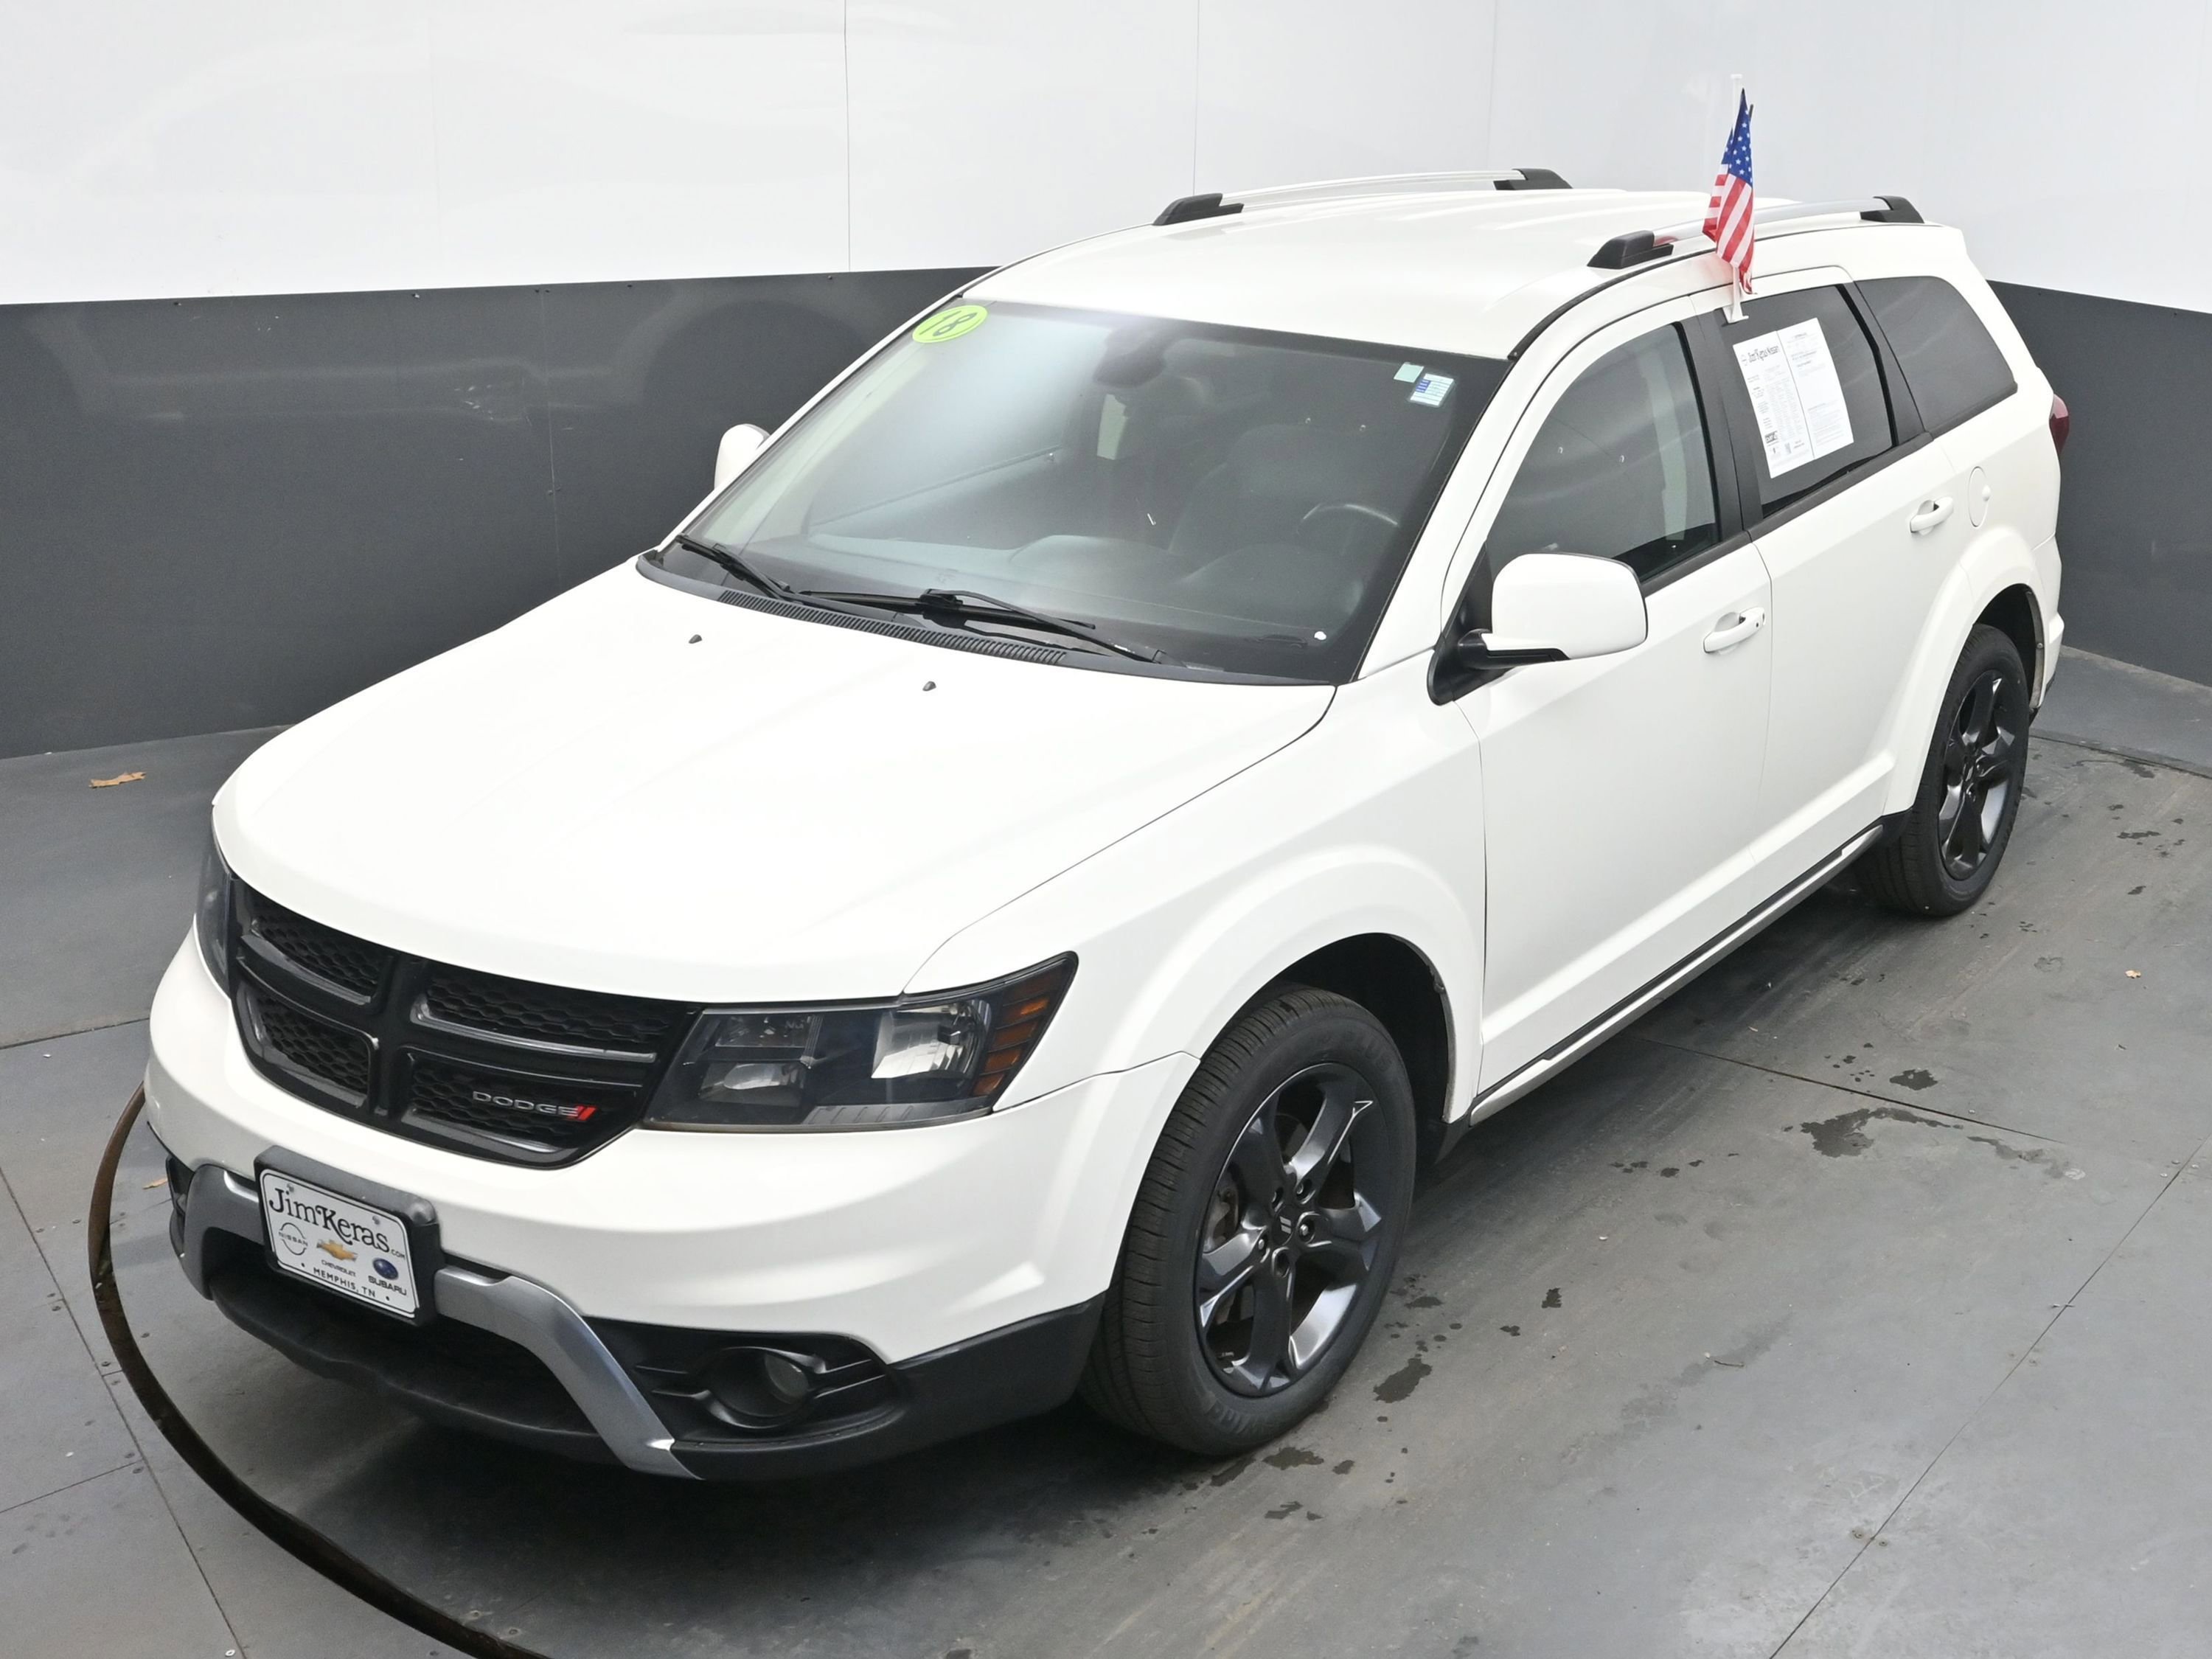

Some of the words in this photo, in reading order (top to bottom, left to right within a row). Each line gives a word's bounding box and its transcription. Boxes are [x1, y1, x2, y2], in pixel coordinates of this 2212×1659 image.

[919, 310, 978, 337] 18
[473, 1091, 578, 1117] DODGE
[279, 1231, 308, 1246] NISSAN
[321, 1259, 356, 1277] CHEVROLET
[361, 1286, 376, 1298] TN
[368, 1275, 407, 1295] SUBARU
